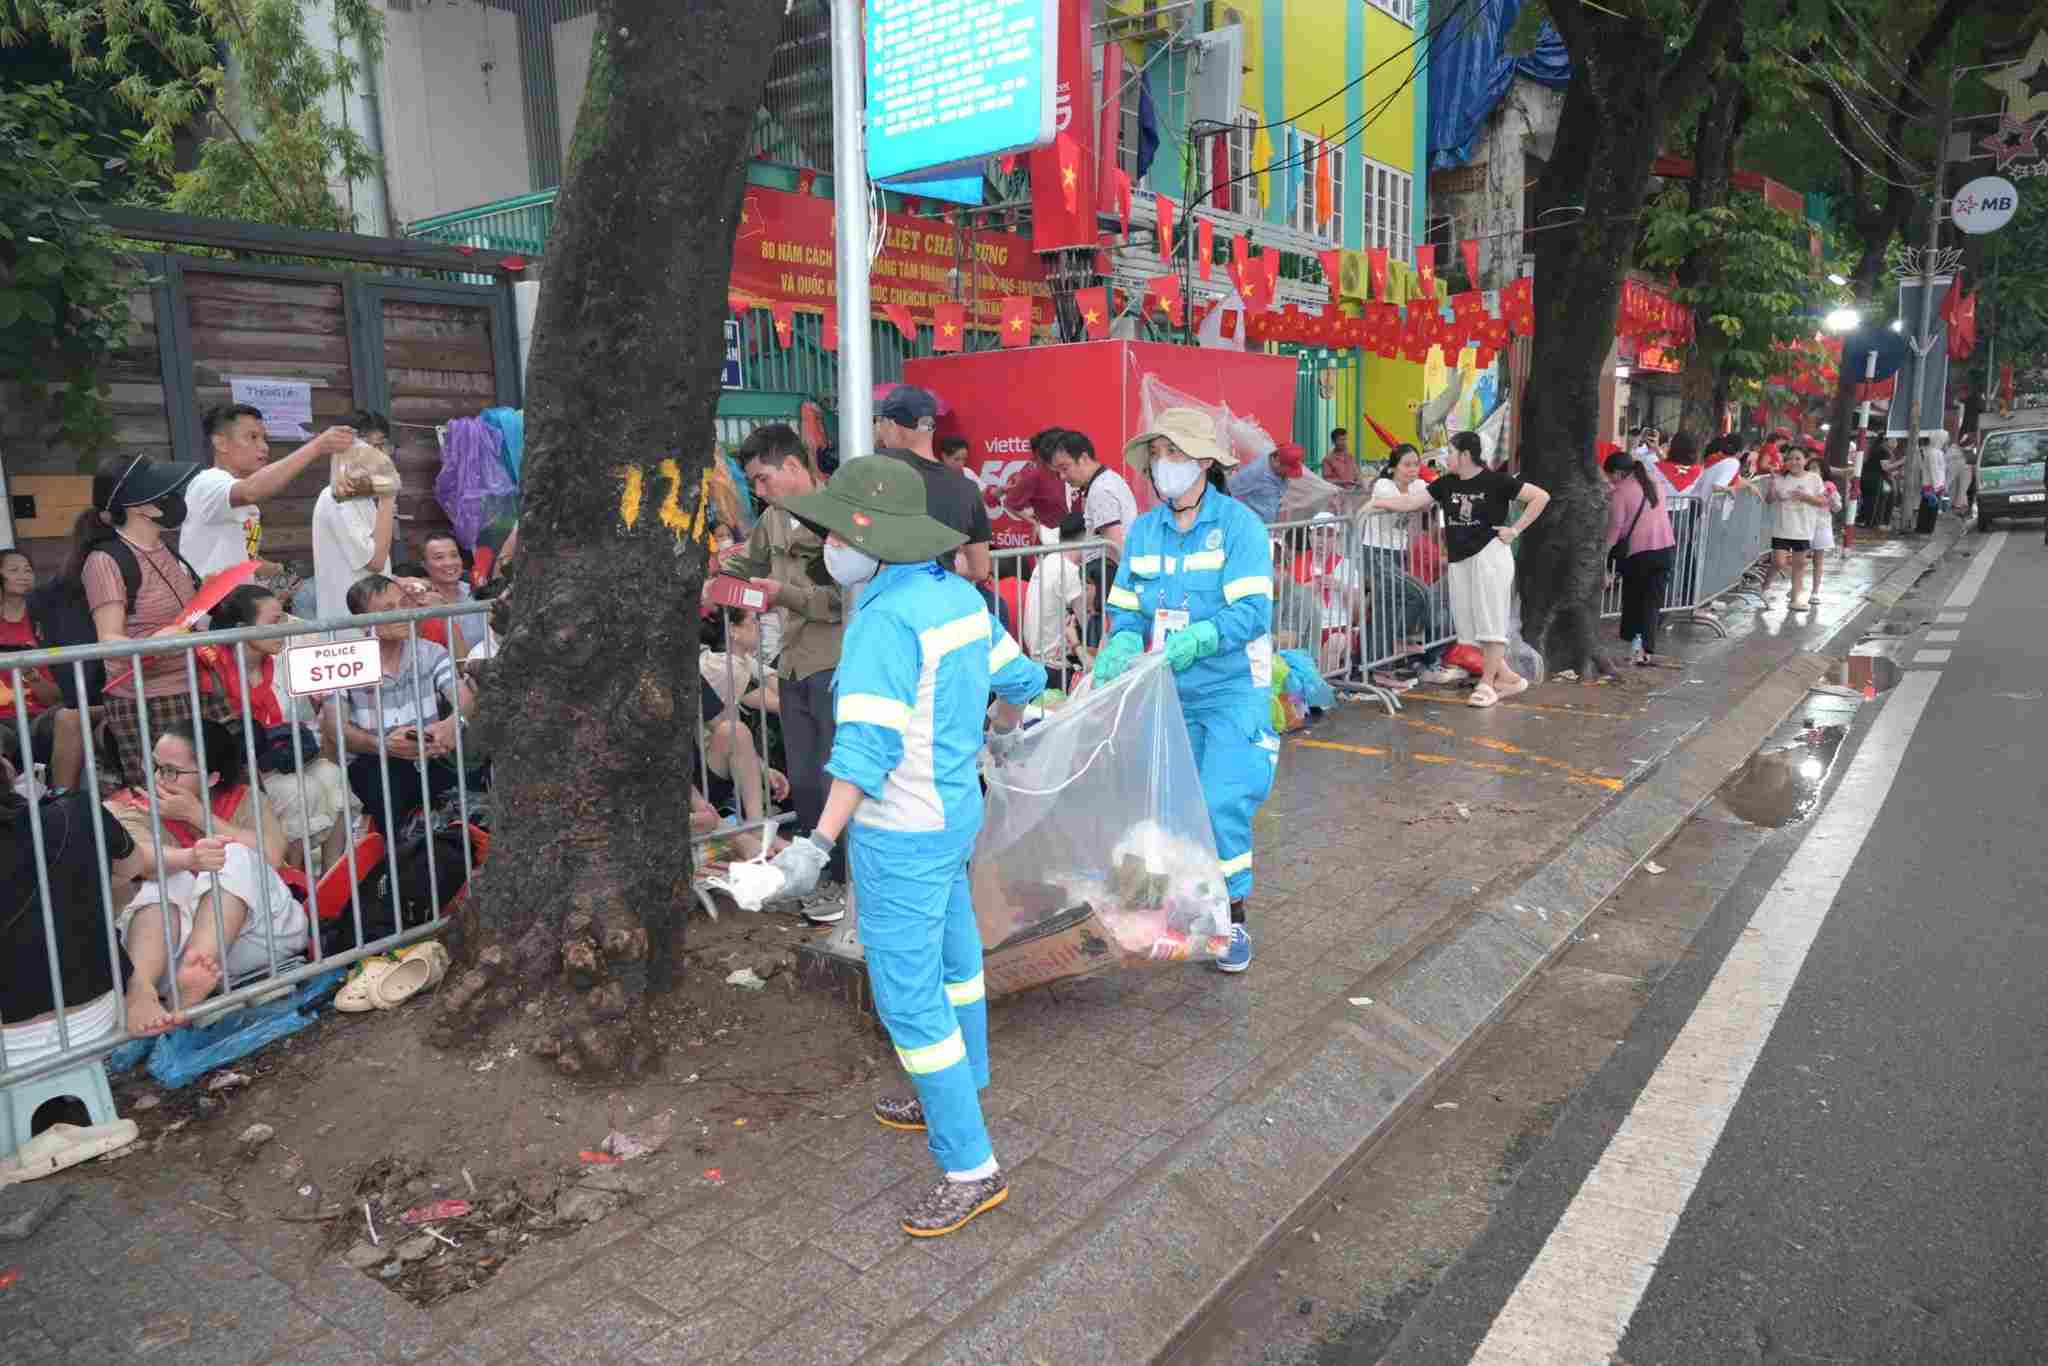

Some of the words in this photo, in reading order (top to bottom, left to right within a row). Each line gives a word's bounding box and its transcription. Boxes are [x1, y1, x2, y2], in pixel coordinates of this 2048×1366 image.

[1981, 196, 2012, 212] MB
[761, 240, 776, 259] 80
[984, 436, 1032, 453] viette
[314, 645, 358, 659] POLICE
[310, 661, 364, 682] STOP
